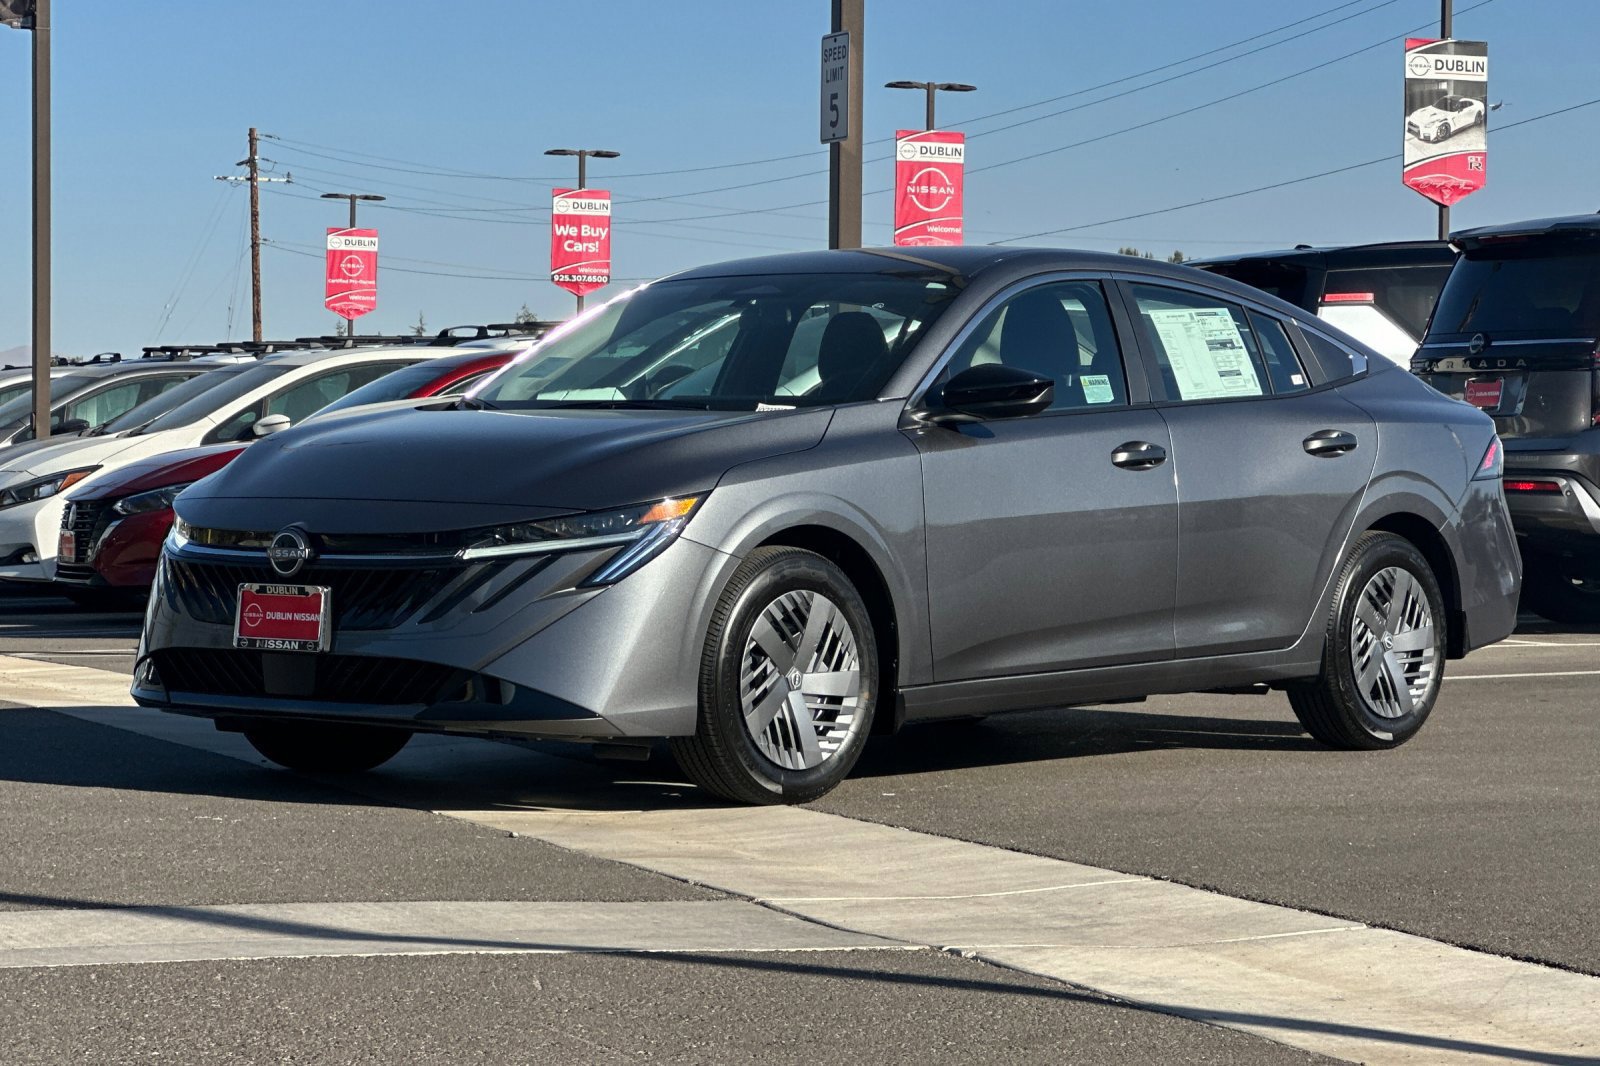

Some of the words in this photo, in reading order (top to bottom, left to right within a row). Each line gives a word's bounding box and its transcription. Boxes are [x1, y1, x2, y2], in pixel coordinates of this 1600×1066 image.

[823, 45, 847, 63] SPEED
[1434, 59, 1485, 73] DUBLIN
[825, 66, 844, 83] LIMIT
[829, 92, 839, 128] 5
[920, 145, 962, 157] DUBLIN
[906, 185, 955, 195] NISSAN
[572, 201, 609, 211] DUBLIN
[555, 224, 578, 237] We
[581, 224, 608, 240] Buy
[926, 225, 962, 234] Welcome!
[344, 238, 376, 247] DUBLIN
[563, 240, 599, 253] Cars!
[578, 266, 609, 274] Welcome!
[553, 274, 608, 283] 925.307.6500
[1431, 358, 1527, 369] ARMADA
[267, 550, 306, 558] NISSAN
[266, 585, 298, 595] DUBLIN
[266, 611, 292, 620] DUBLIN
[293, 612, 320, 621] NISSAN
[256, 639, 299, 650] NISSAN
